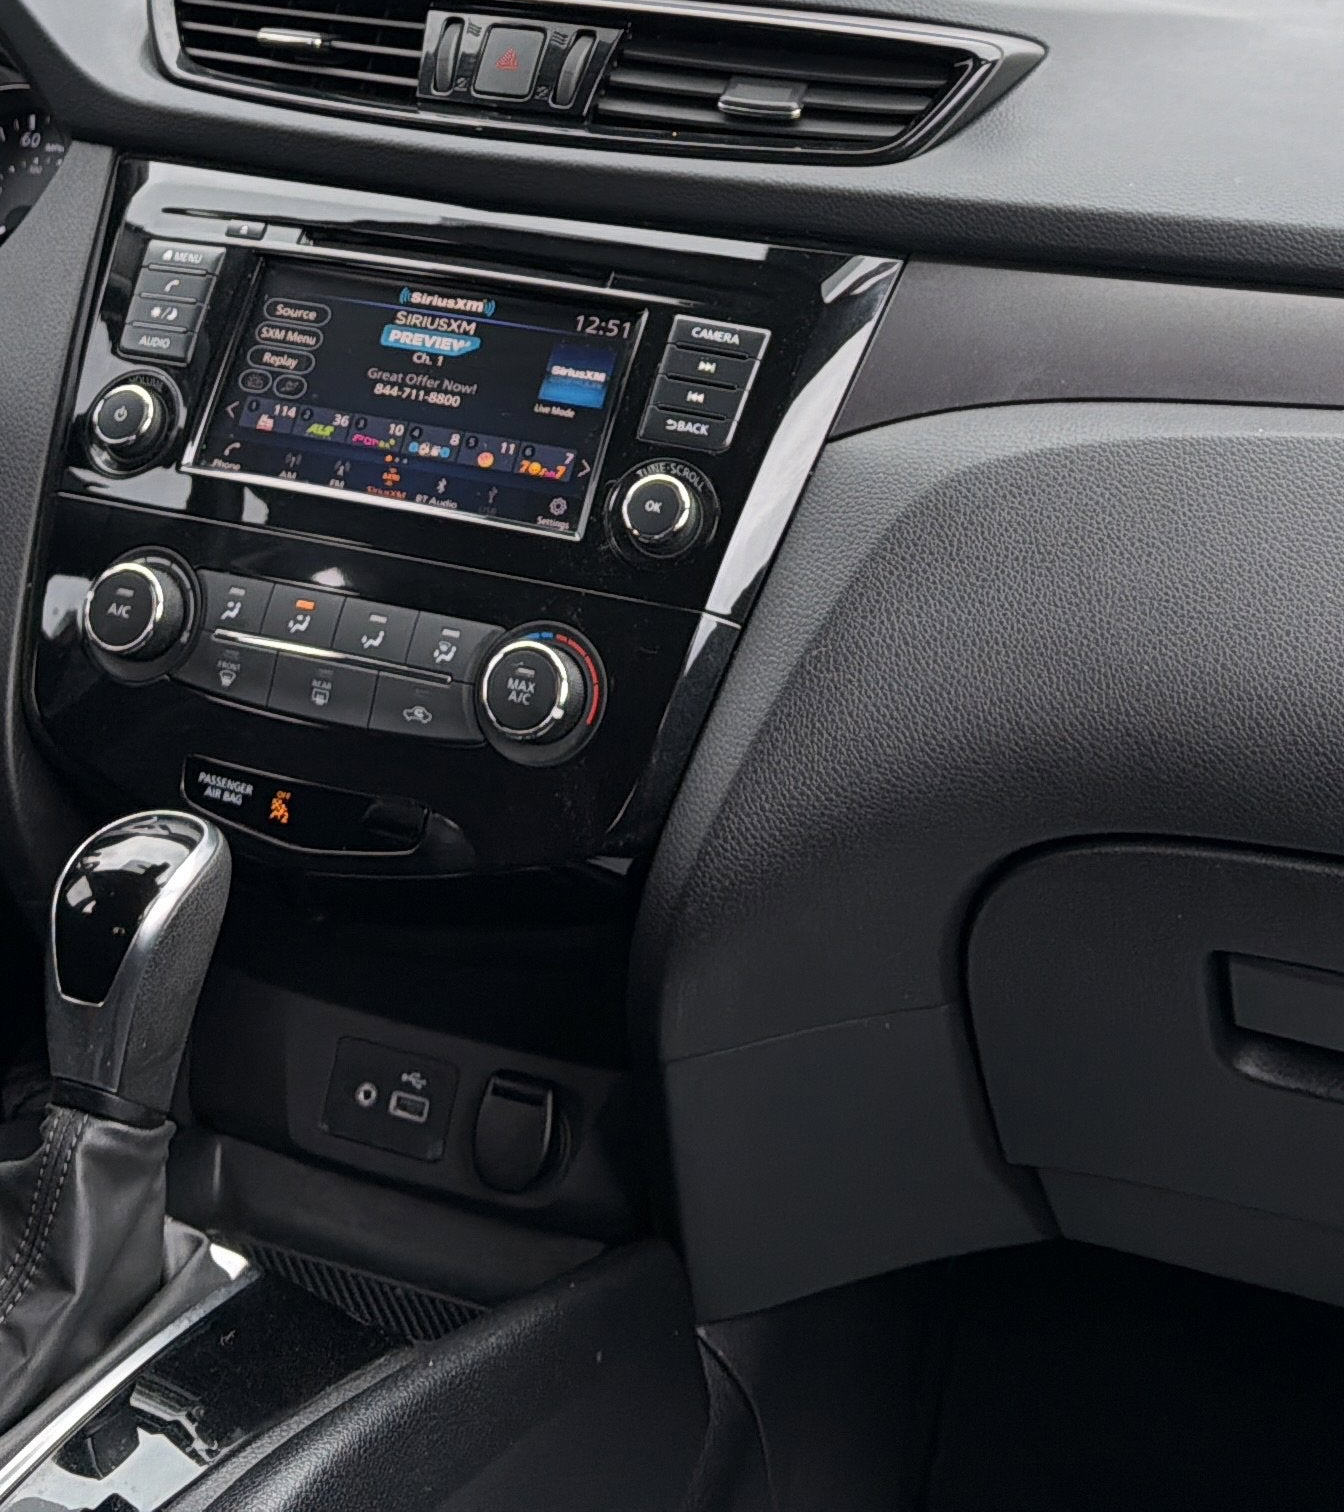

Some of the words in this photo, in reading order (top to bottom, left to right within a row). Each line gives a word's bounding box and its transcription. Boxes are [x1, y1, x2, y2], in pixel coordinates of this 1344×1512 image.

[20, 132, 41, 148] 60
[173, 251, 204, 264] MENU
[275, 303, 318, 321] Source
[394, 311, 477, 335] SIRIUSXM
[575, 314, 632, 339] 12:51
[138, 335, 171, 349] AUDIO
[260, 326, 285, 341] SXM
[286, 329, 317, 346] Menu
[389, 329, 471, 351] PREVIEW
[691, 326, 740, 345] CAMERA
[262, 352, 299, 370] Replay
[412, 352, 433, 366] Ch.
[436, 355, 444, 367] 1
[367, 367, 404, 384] Great
[405, 372, 441, 388] Offer
[442, 377, 477, 395] Now!
[374, 383, 461, 407] 844-711-8800
[273, 404, 297, 419] 114
[332, 413, 350, 427] 36
[676, 420, 709, 436] BACK
[389, 423, 405, 437] 10
[450, 433, 461, 446] 8
[500, 442, 516, 455] 11
[564, 452, 575, 465] 7
[429, 497, 458, 509] Audio
[644, 500, 663, 513] OK
[536, 515, 570, 530] Settings
[107, 603, 131, 619] A/C
[217, 660, 241, 671] FRONT
[507, 677, 535, 694] MAX
[507, 691, 531, 706] A/C
[198, 771, 254, 797] PASSENGER
[203, 786, 221, 799] AIR
[222, 791, 243, 806] BAG
